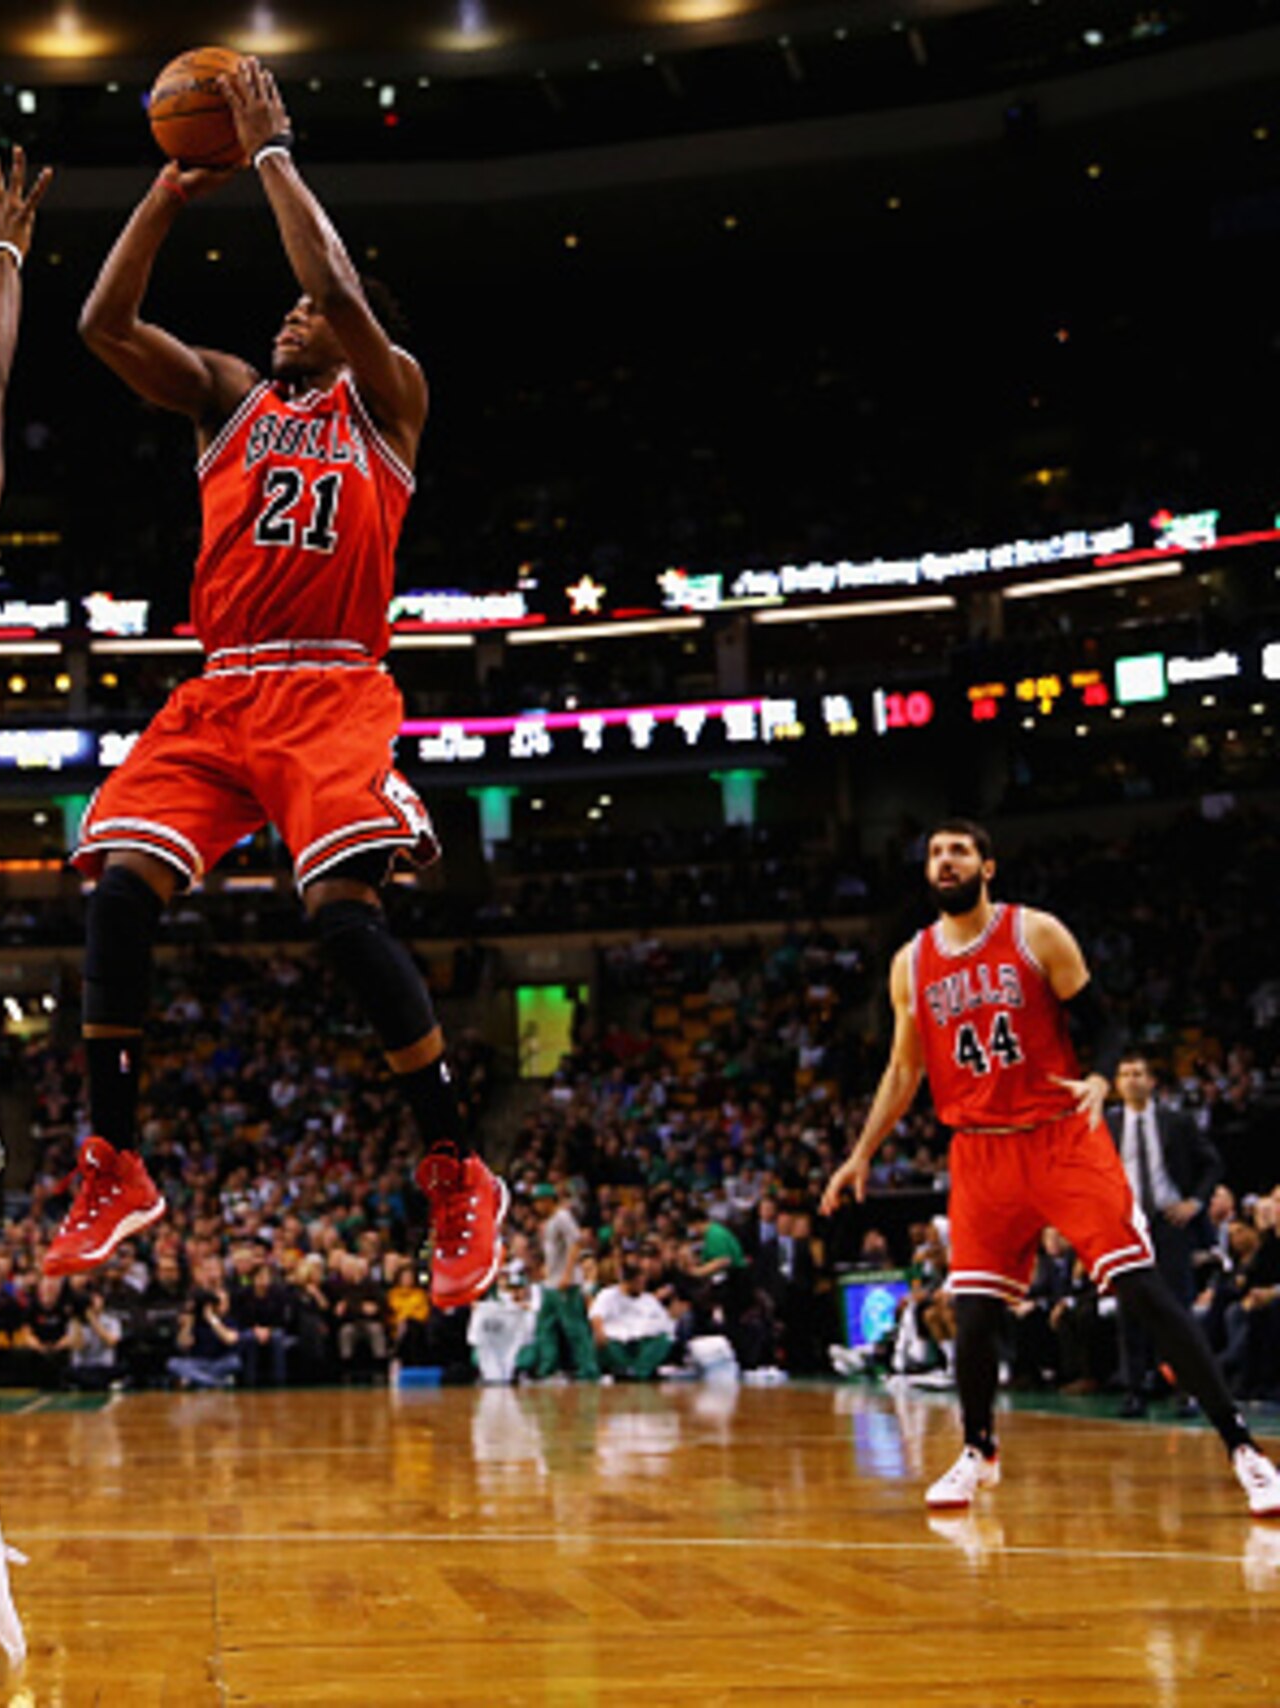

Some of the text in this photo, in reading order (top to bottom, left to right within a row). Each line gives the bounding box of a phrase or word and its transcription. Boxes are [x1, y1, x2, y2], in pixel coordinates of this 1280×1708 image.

[254, 467, 342, 553] 21
[885, 691, 934, 728] 10
[925, 964, 1024, 1027] BULLS
[953, 1011, 1025, 1076] 44
